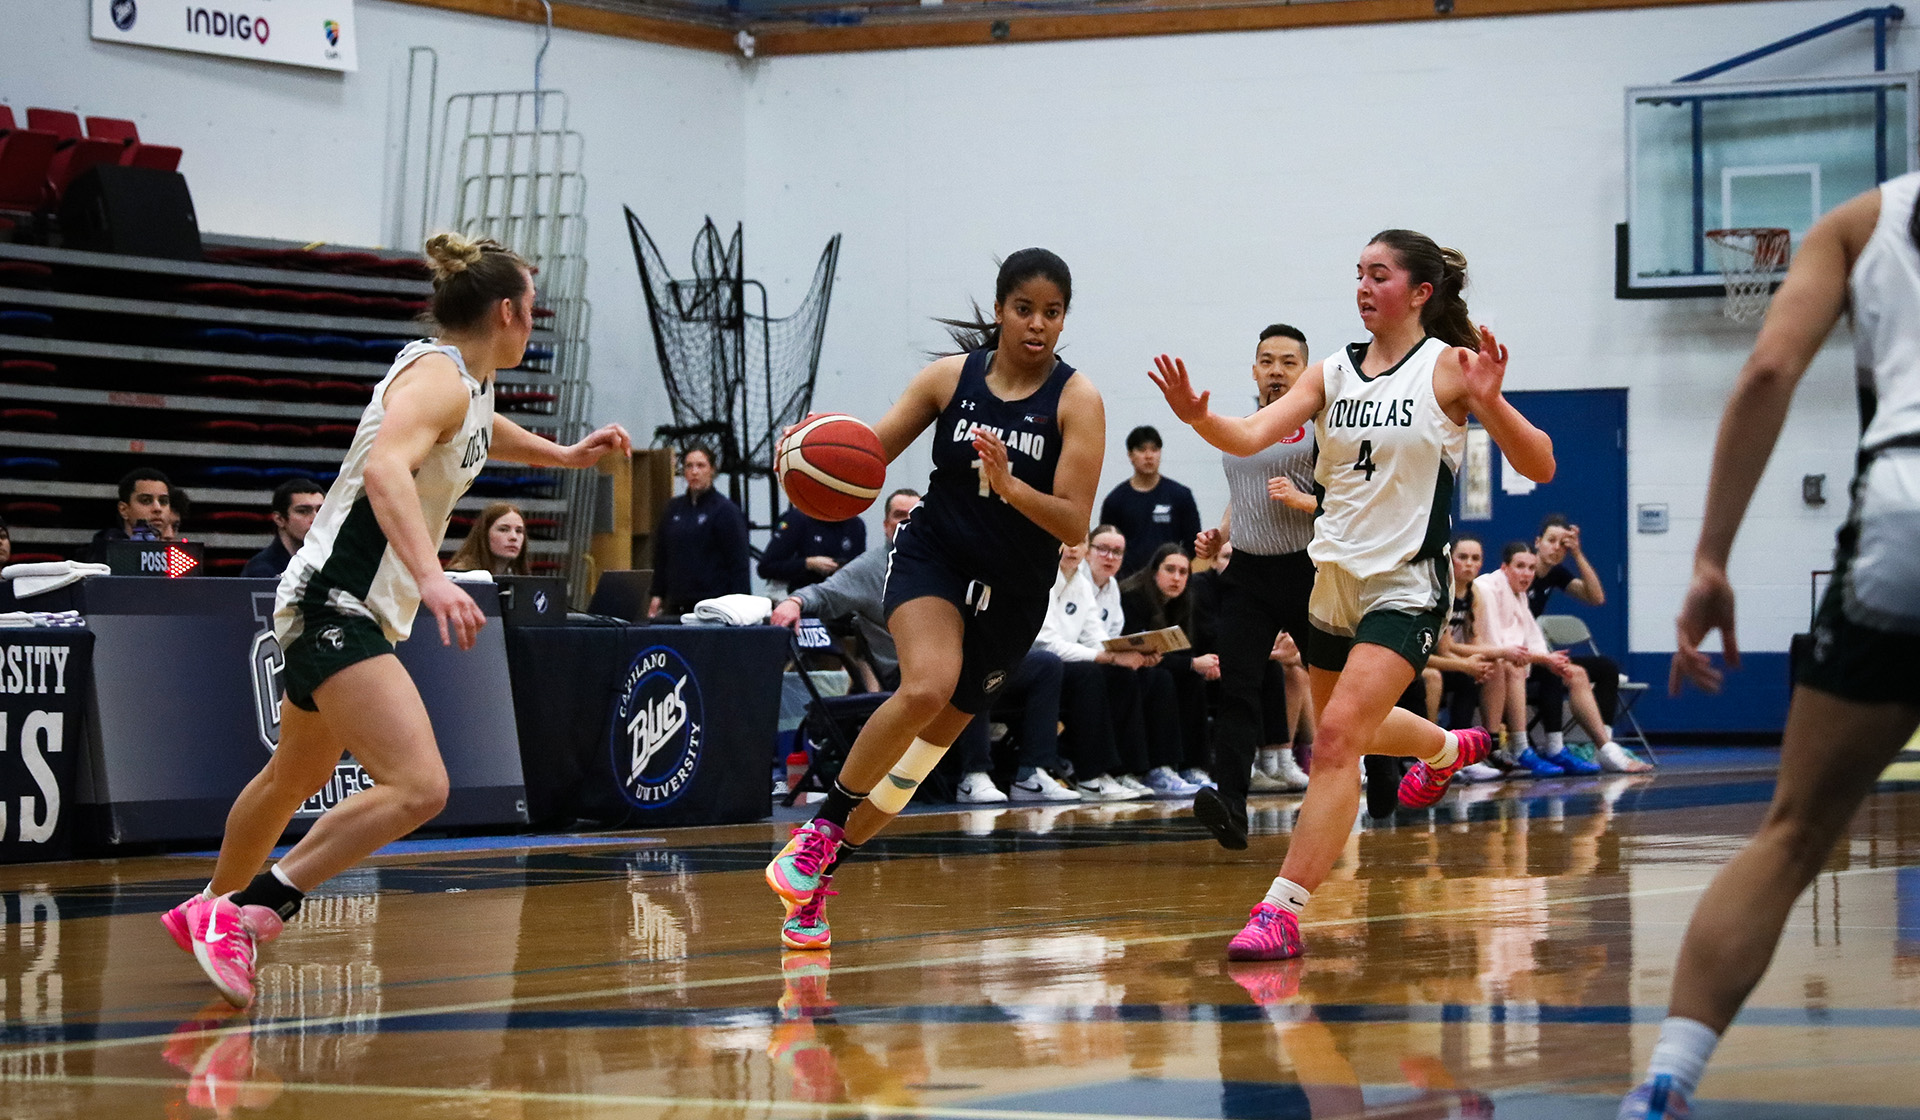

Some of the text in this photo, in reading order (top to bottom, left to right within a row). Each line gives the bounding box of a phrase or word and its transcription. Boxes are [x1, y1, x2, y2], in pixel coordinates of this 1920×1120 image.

[186, 7, 270, 45] INDIGO
[970, 459, 1014, 504] 1
[1353, 440, 1376, 481] 4
[619, 653, 666, 718] CAPILANO
[626, 674, 687, 788] Blues
[635, 722, 701, 801] UNIVERSITY
[0, 709, 64, 844] S
